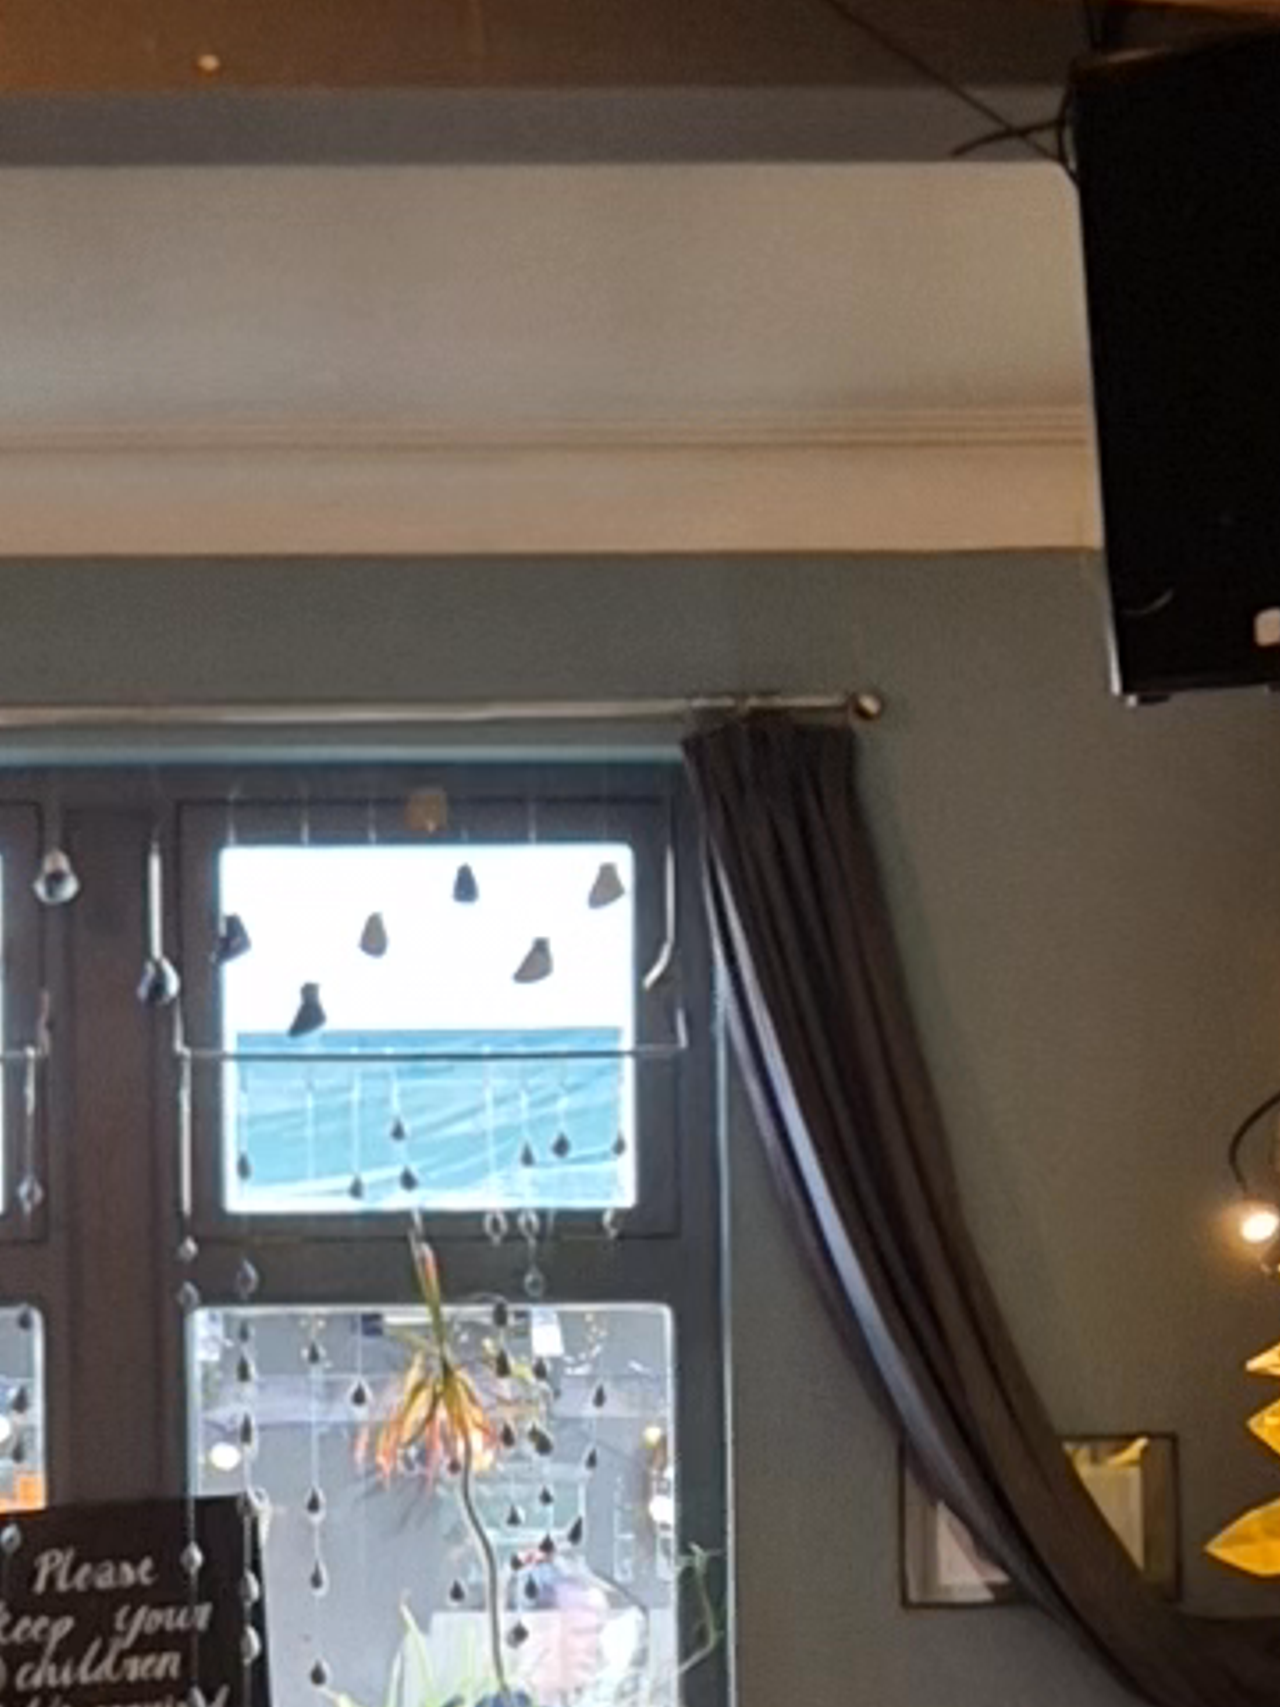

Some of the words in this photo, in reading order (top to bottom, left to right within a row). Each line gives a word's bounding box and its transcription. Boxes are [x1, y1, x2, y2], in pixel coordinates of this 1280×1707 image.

[32, 1546, 158, 1594] Please
[114, 1602, 213, 1649] your
[15, 1637, 181, 1691] children
